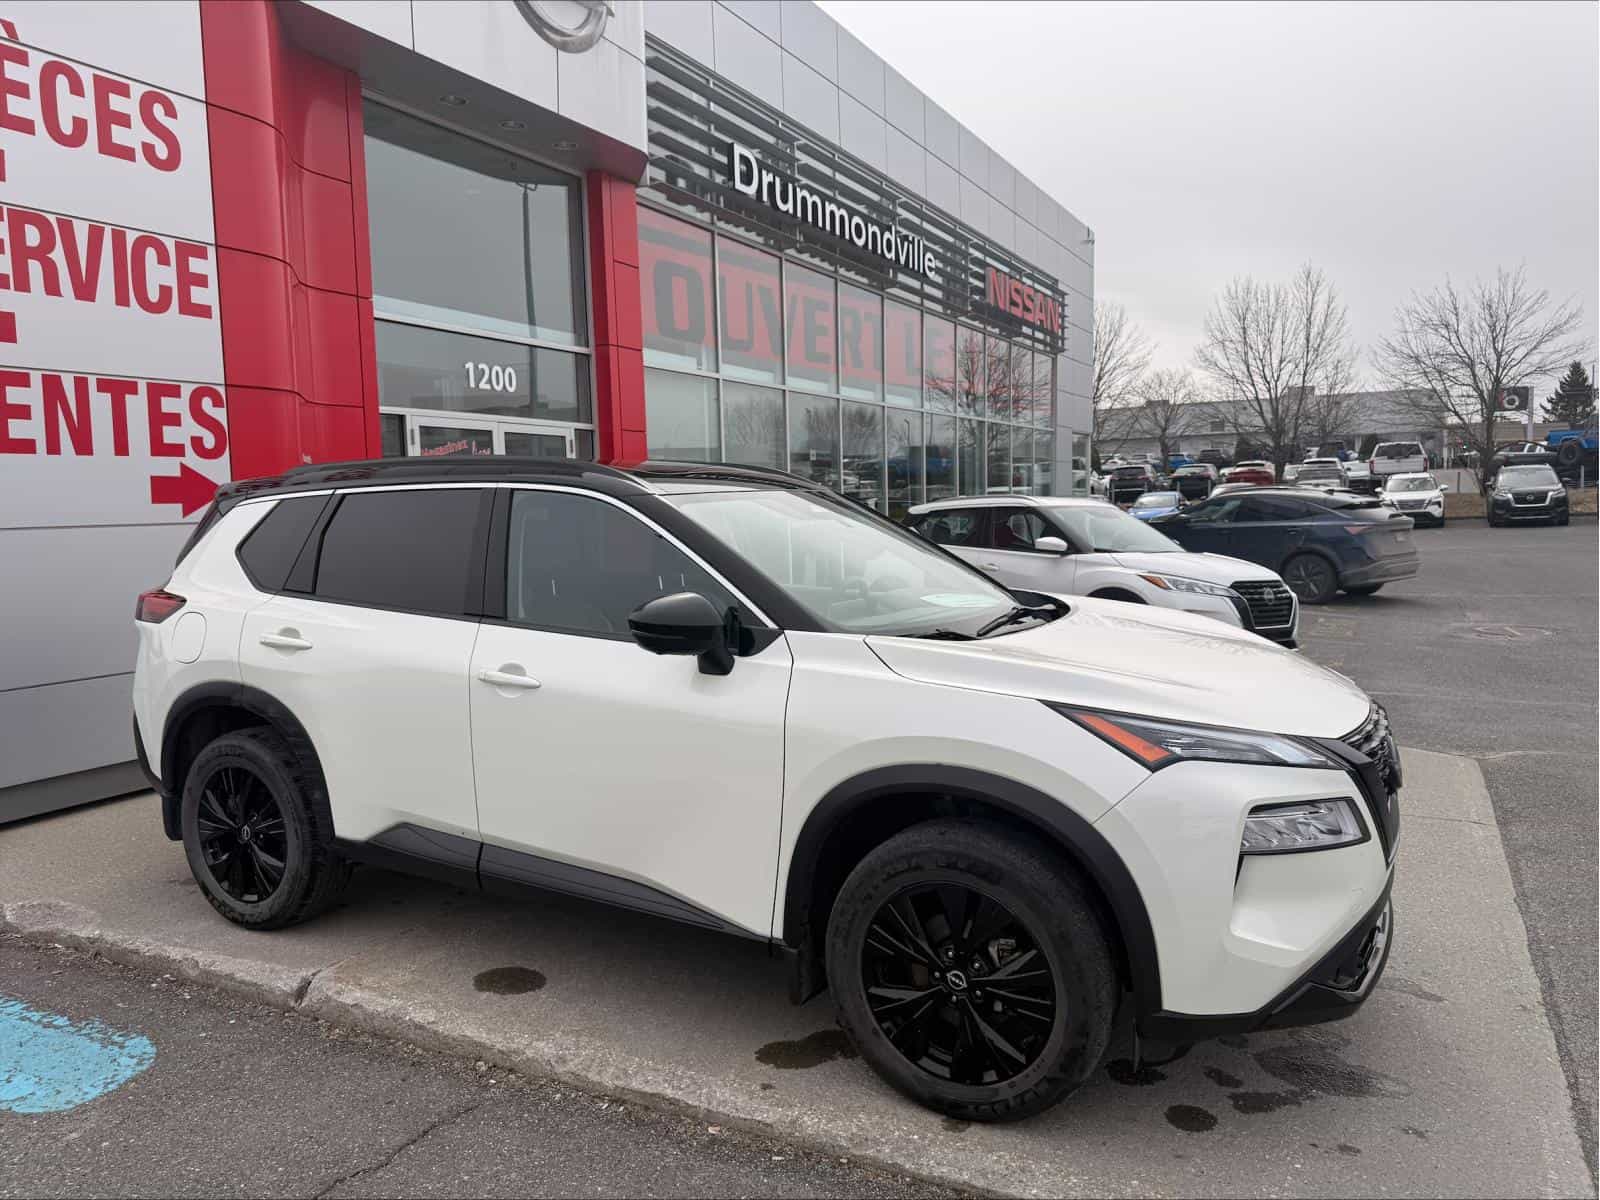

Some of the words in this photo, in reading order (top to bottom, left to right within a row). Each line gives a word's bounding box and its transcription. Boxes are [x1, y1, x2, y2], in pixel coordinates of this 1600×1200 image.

[729, 142, 937, 279] Drummondville
[654, 259, 883, 372] OUVERT
[987, 266, 1062, 335] NISSAN
[464, 361, 517, 393] 1200
